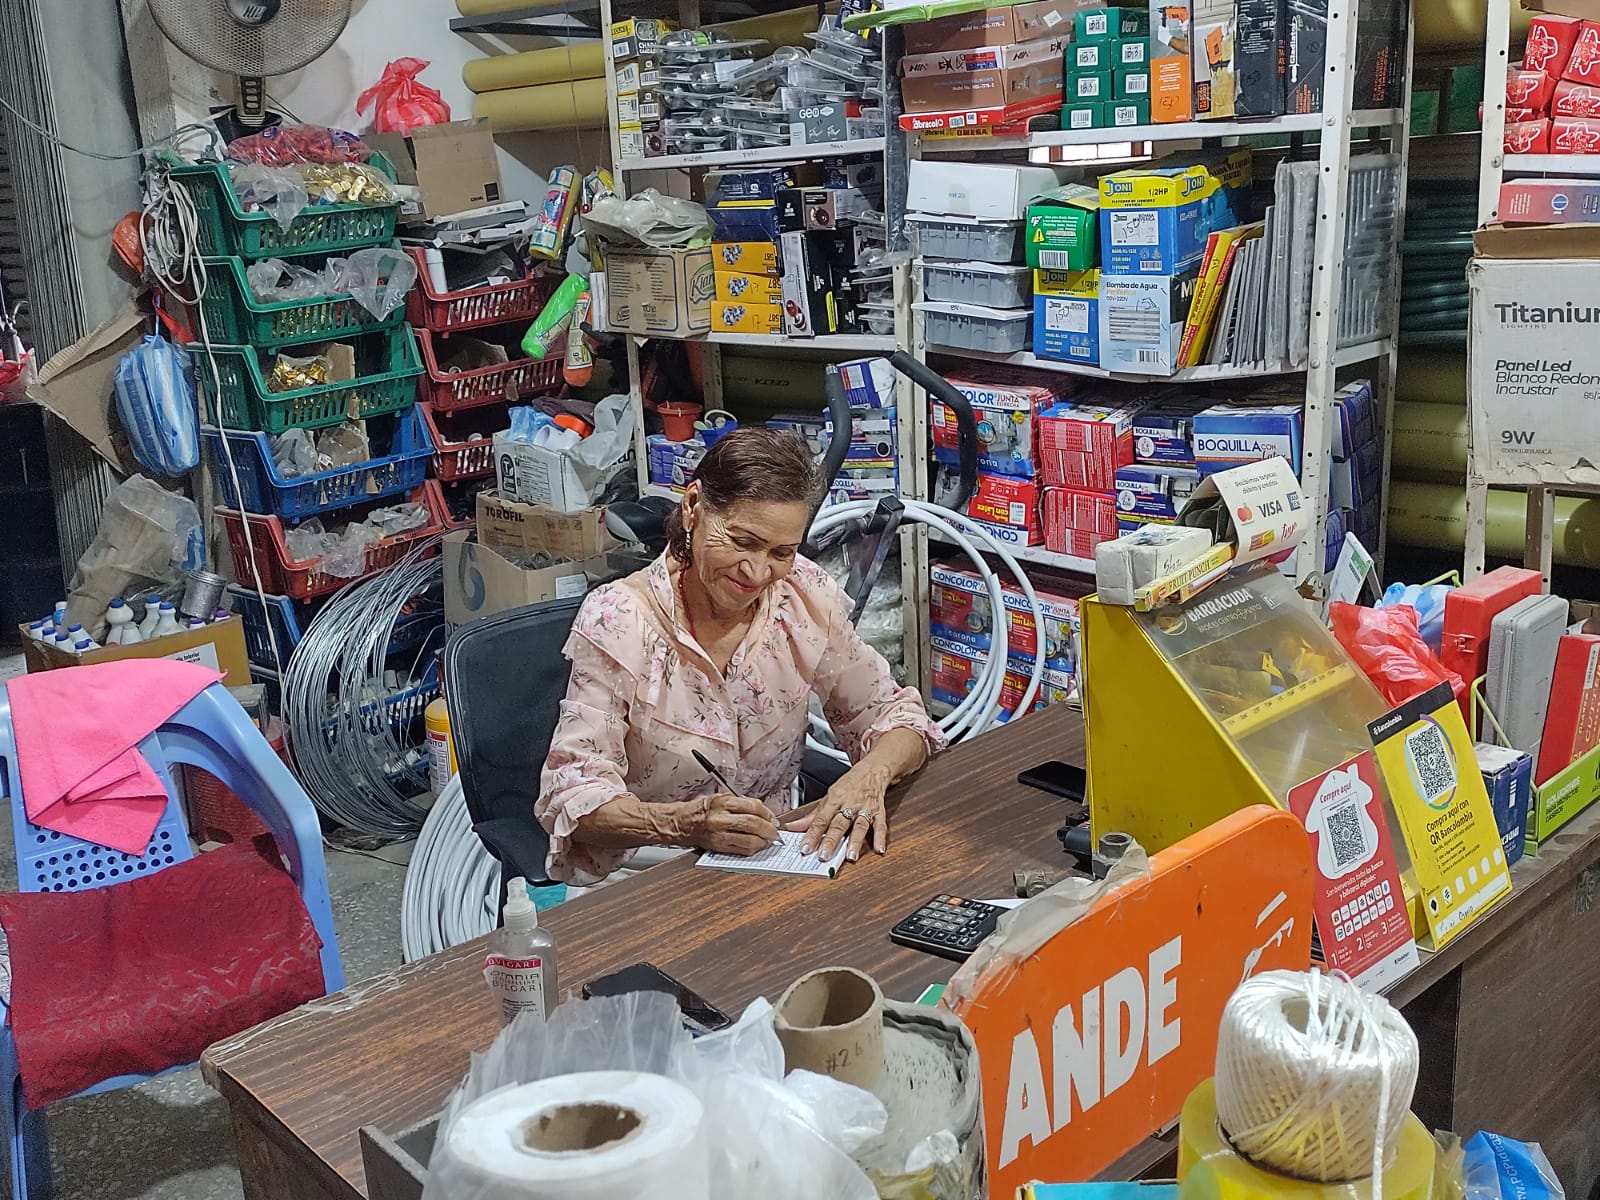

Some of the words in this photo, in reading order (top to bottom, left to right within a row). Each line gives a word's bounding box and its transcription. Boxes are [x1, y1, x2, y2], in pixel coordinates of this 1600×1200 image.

[1106, 282, 1131, 290] Bomba
[1141, 282, 1158, 291] Agua
[1495, 360, 1540, 372] Panel
[1542, 360, 1572, 372] Led
[1496, 372, 1548, 384] Blanco
[1496, 384, 1558, 396] Incrustar
[1501, 430, 1536, 445] 9W
[1198, 439, 1262, 453] BOQUILLA
[977, 456, 998, 468] rona
[1258, 500, 1283, 518] VISA
[934, 571, 978, 590] CONCOLOR
[1168, 572, 1192, 591] FRUIT
[1192, 560, 1212, 579] PUNCH
[1186, 588, 1254, 624] BARRACUDA
[934, 637, 977, 657] CONCOLOR
[1320, 788, 1336, 804] Compre
[1336, 782, 1352, 797] aquí
[1426, 812, 1448, 833] Compra
[1448, 804, 1460, 823] aquí
[1460, 798, 1470, 812] con
[1429, 830, 1443, 846] QR
[1441, 811, 1474, 840] Bancolombia
[1380, 921, 1388, 935] 3
[1356, 936, 1364, 950] 2
[488, 960, 536, 968] BVLGARI
[1331, 952, 1338, 965] 1
[998, 934, 1182, 1170] ANDE
